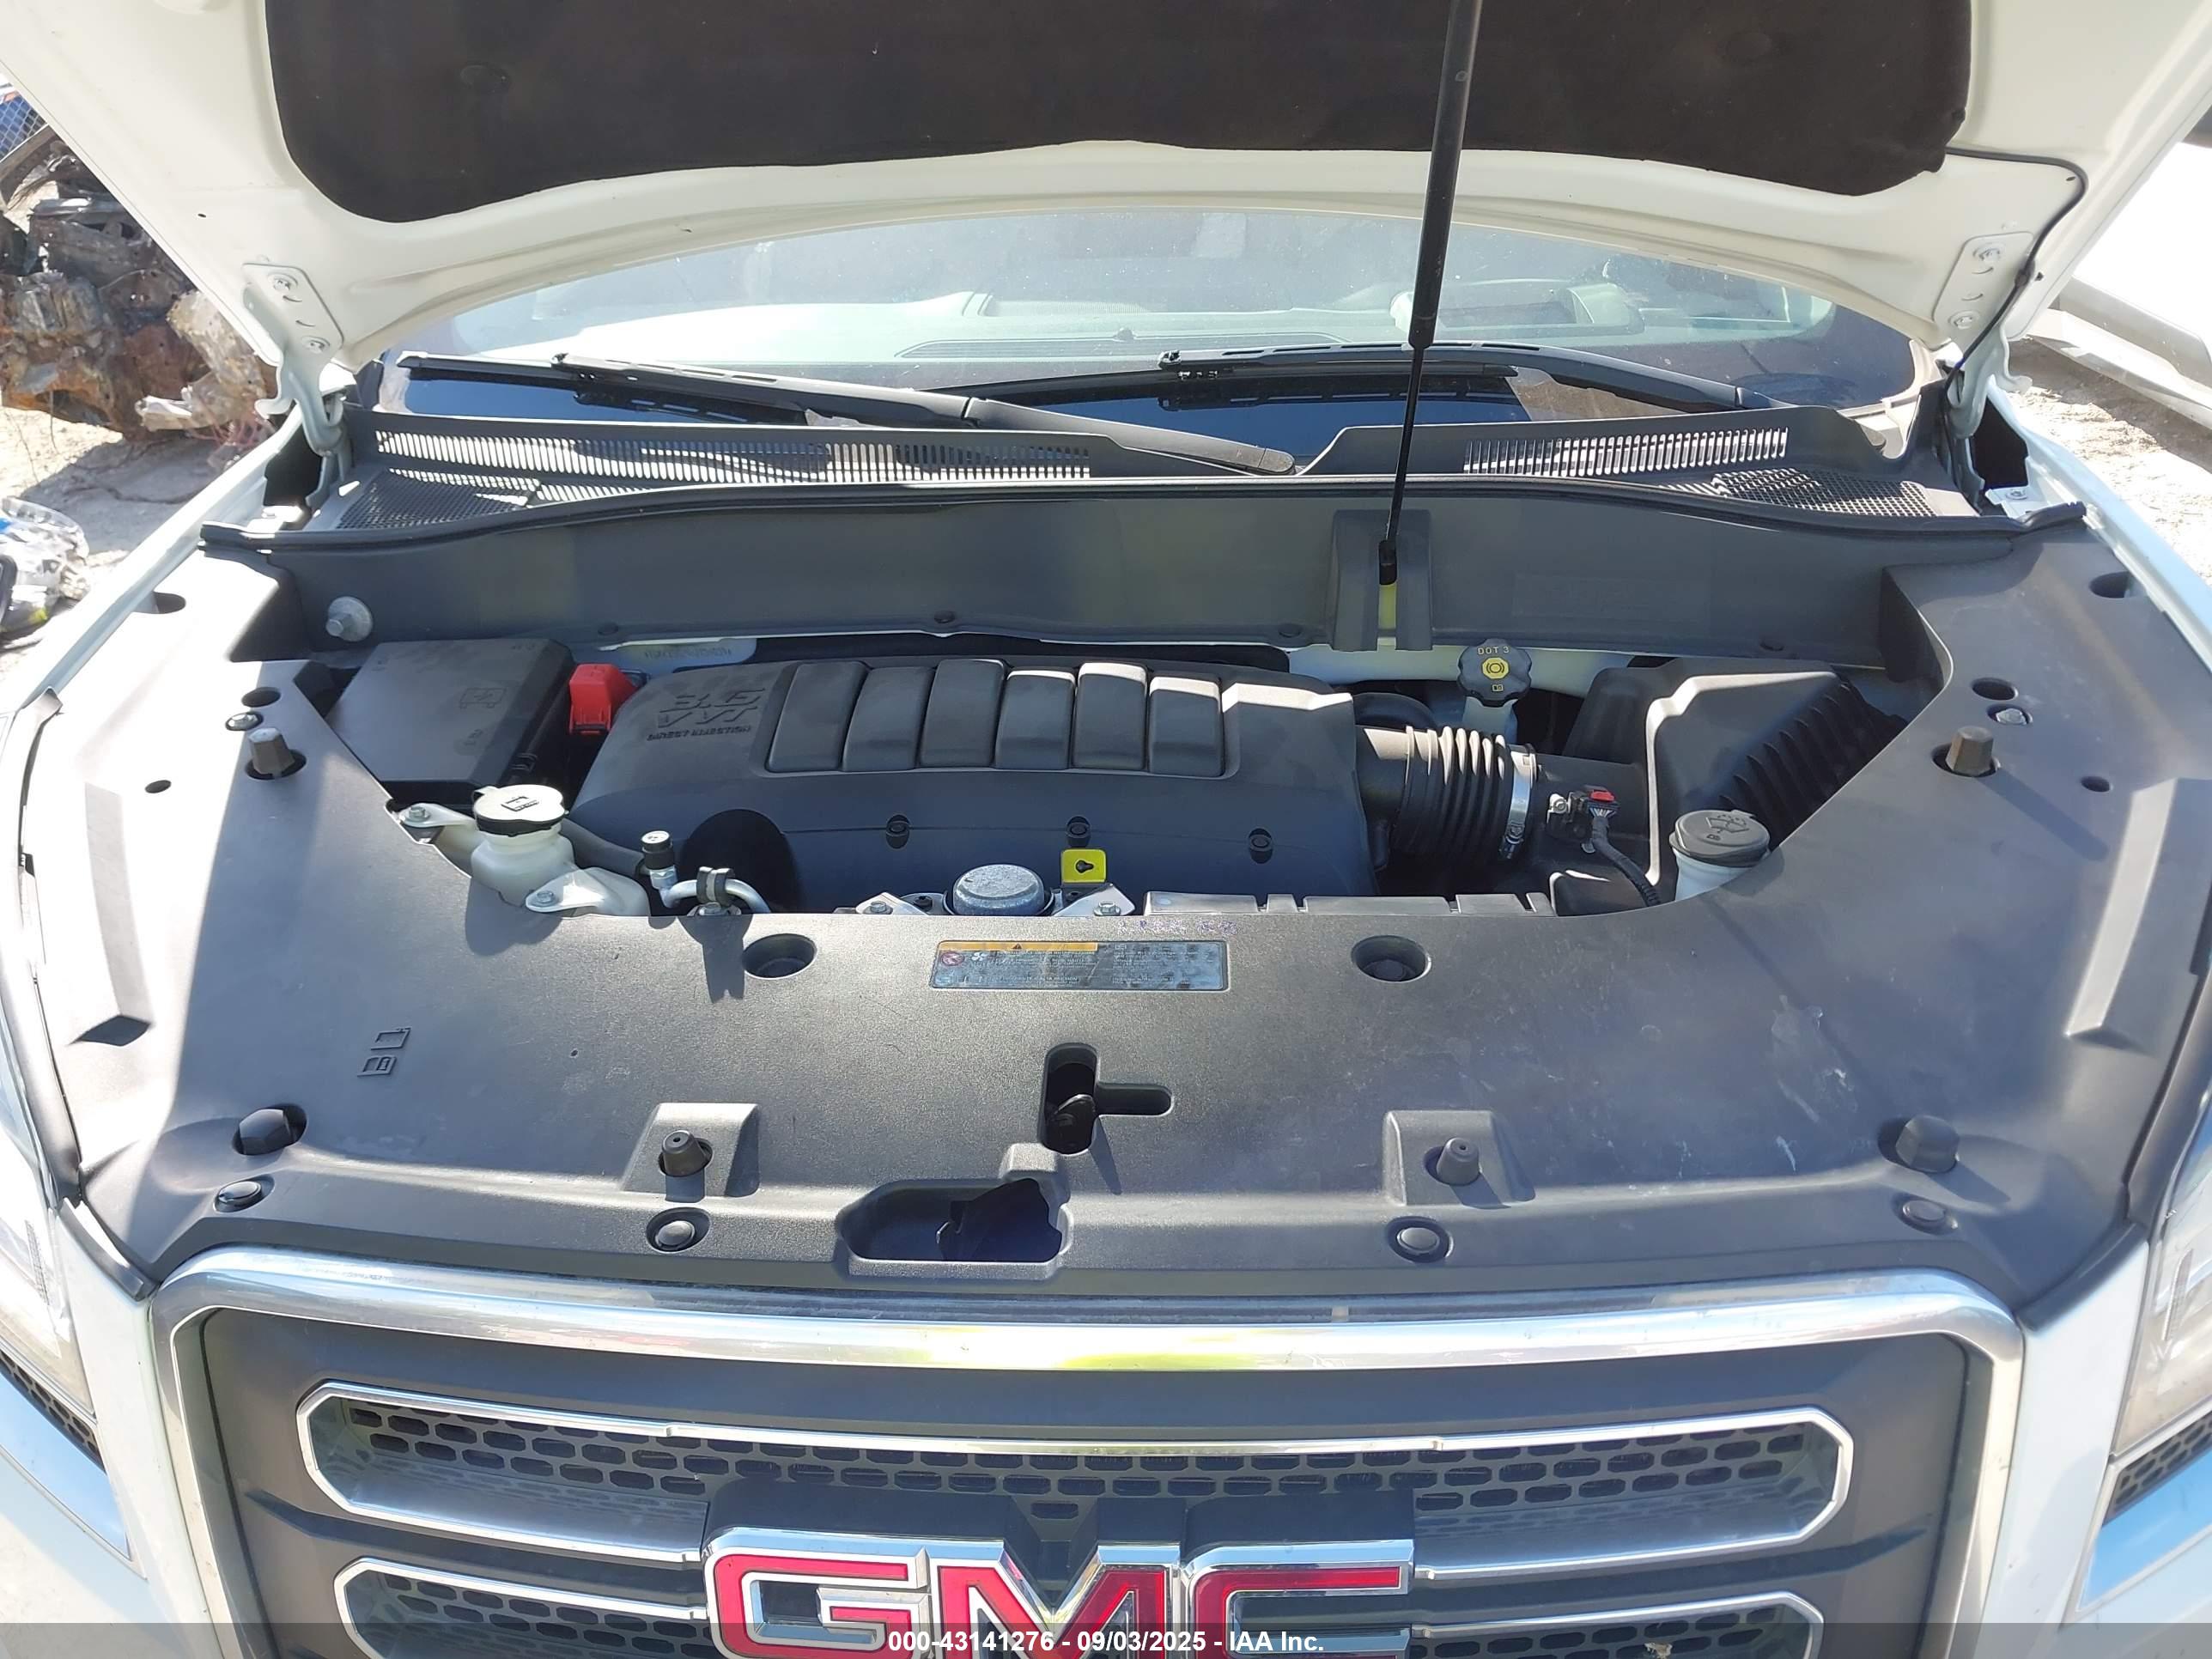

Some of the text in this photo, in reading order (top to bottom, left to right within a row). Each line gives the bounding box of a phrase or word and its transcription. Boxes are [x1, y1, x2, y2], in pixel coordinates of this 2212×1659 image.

[1478, 647, 1499, 655] DOT
[659, 688, 766, 714] 3.6
[702, 1526, 1414, 1659] GMC
